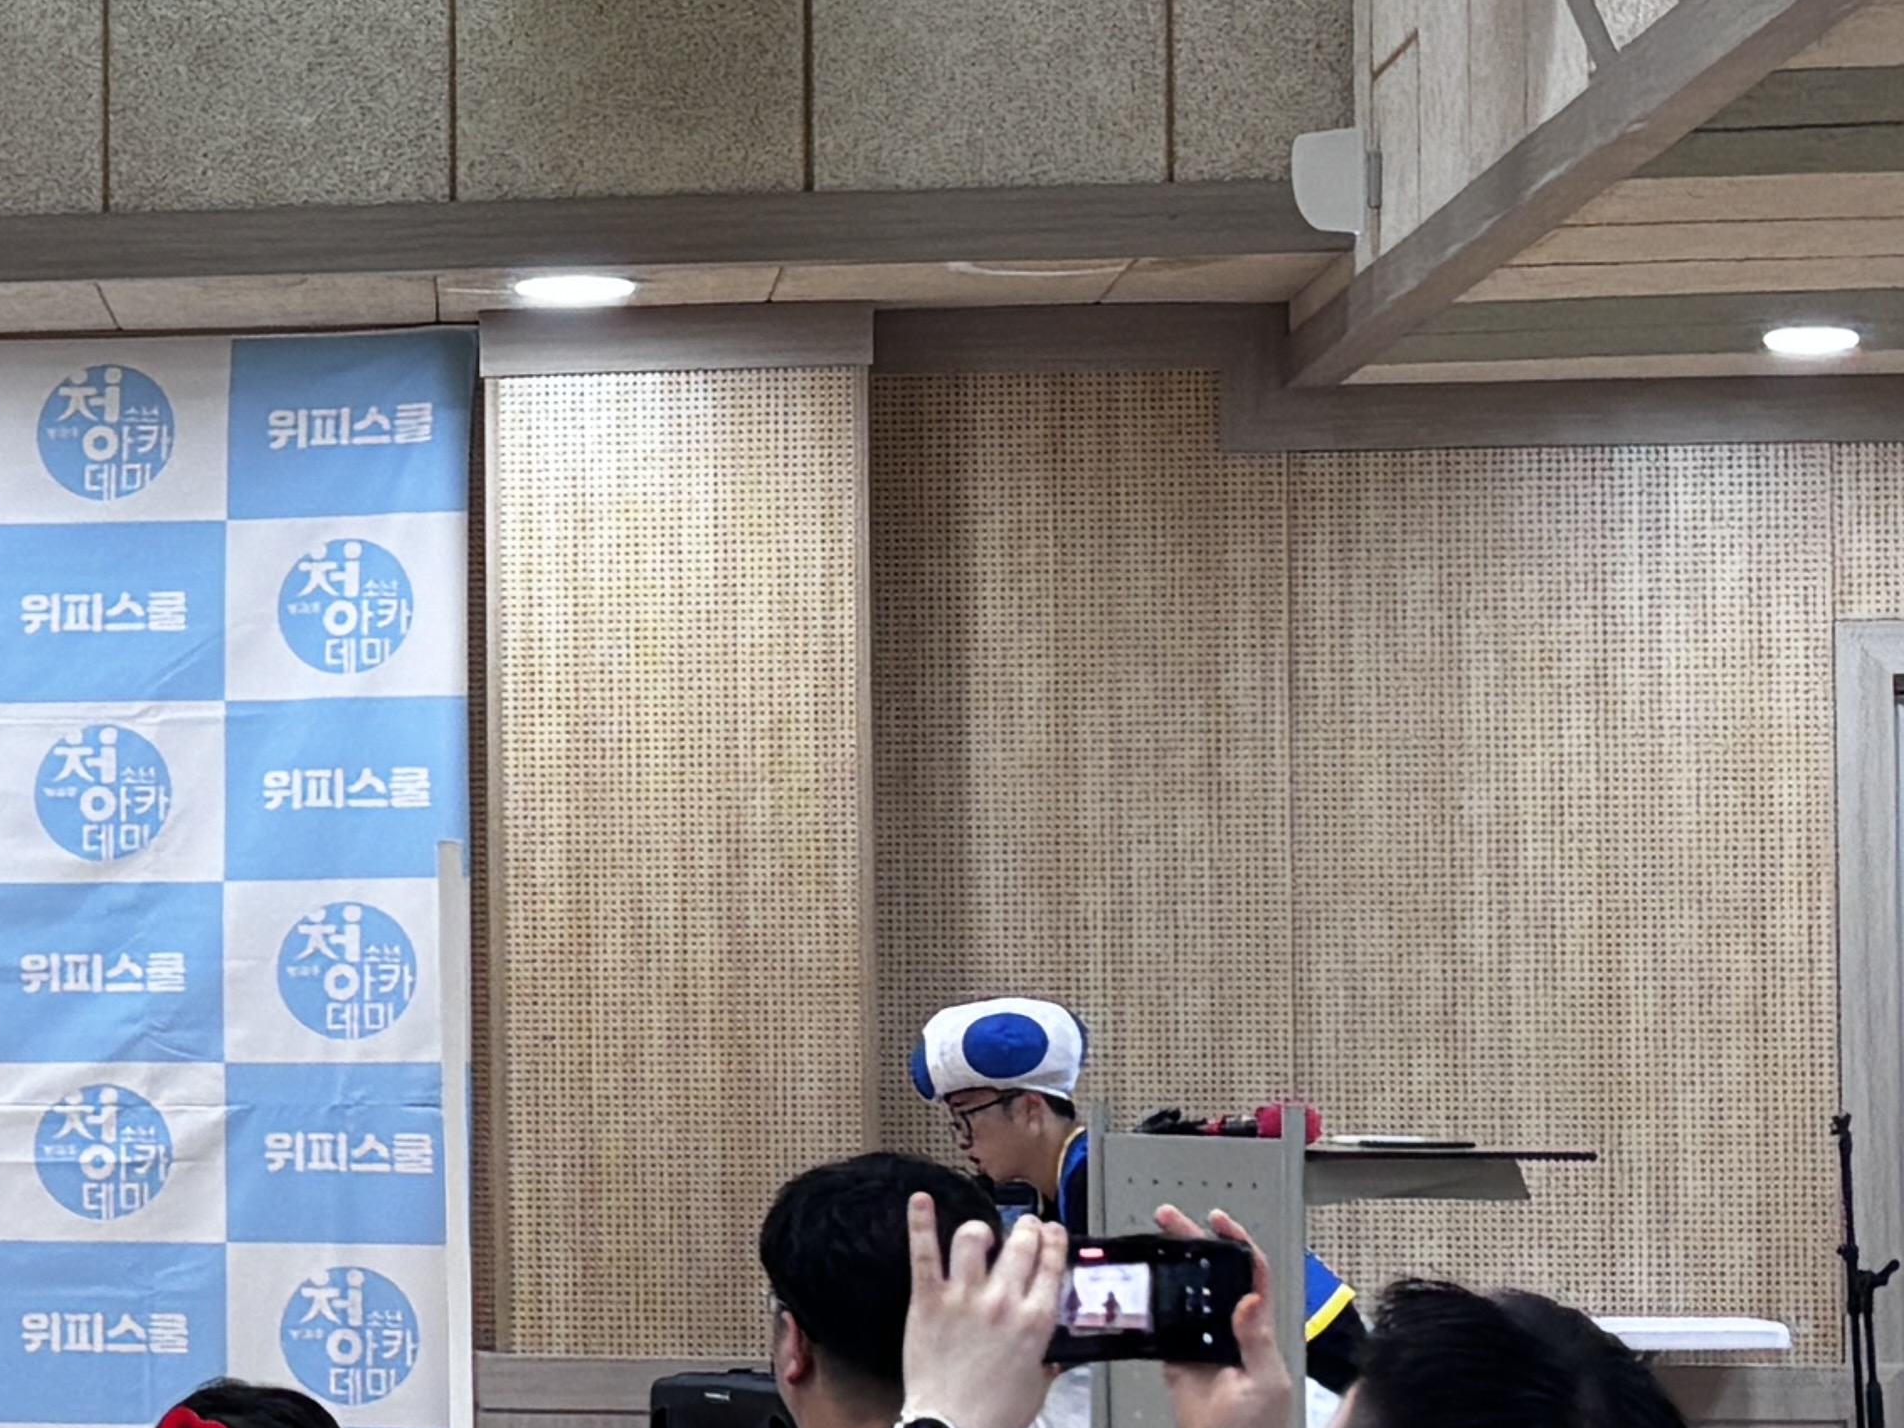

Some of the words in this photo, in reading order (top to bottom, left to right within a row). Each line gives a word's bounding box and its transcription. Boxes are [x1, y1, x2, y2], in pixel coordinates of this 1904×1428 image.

[269, 403, 432, 449] 위피스쿨
[22, 592, 186, 634] 위피스쿨
[264, 767, 430, 810] 위피스쿨
[21, 953, 185, 993] 위피스쿨
[266, 1133, 433, 1174] 위피스쿨
[22, 1313, 188, 1354] 위피스쿨
